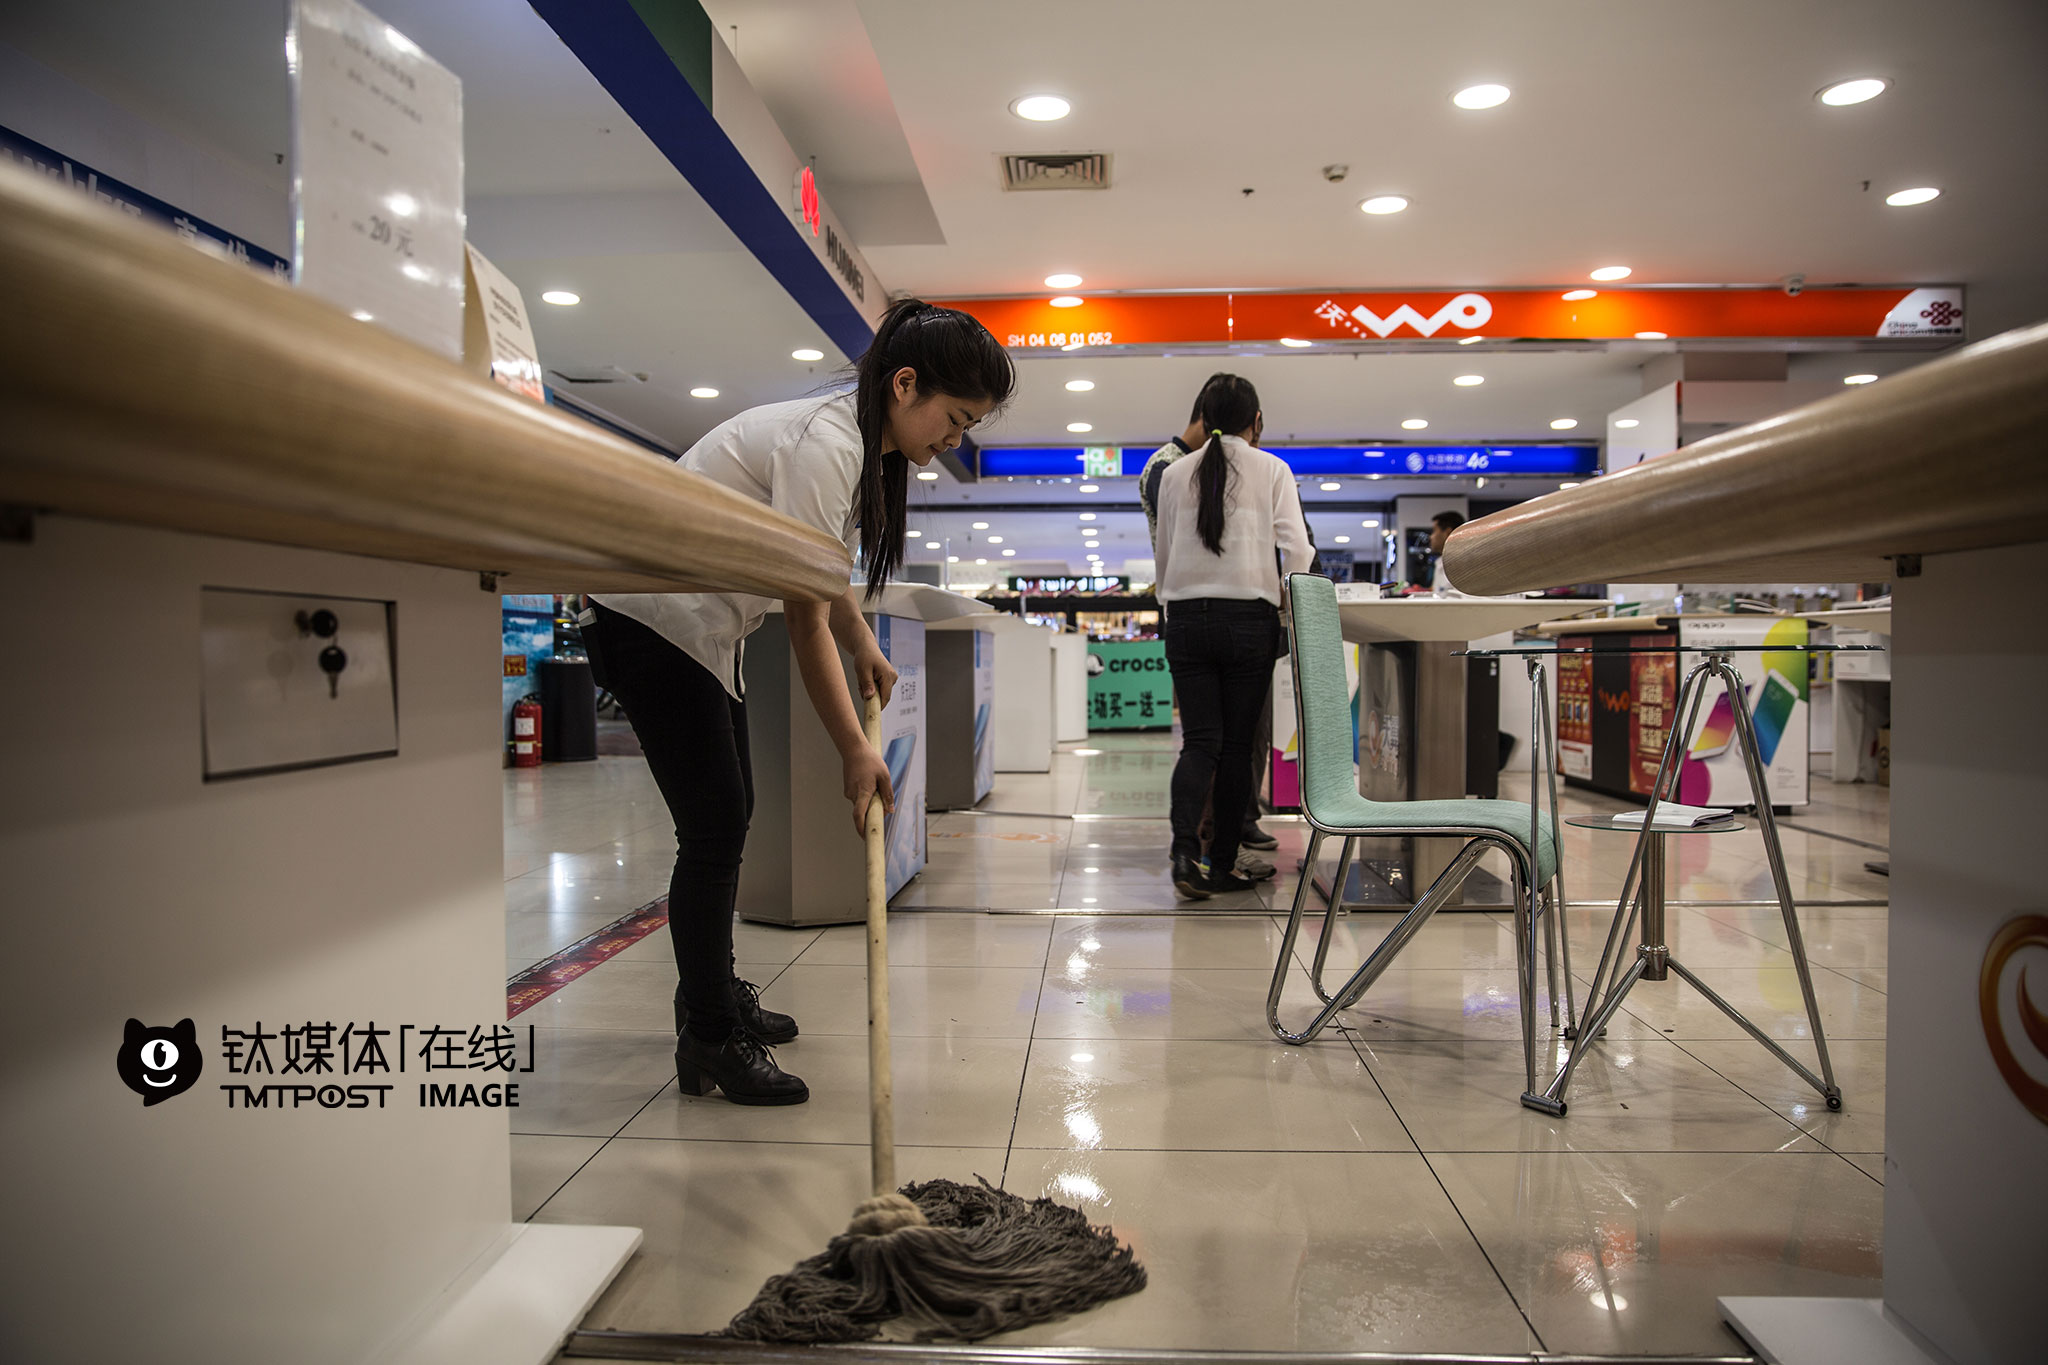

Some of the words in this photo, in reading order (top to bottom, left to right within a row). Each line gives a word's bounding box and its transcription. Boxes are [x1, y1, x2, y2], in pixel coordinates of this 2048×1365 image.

[367, 214, 392, 249] 20
[827, 225, 864, 303] HUAWEI
[1007, 333, 1026, 347] SH
[1029, 333, 1046, 347] 04
[1070, 332, 1086, 346] 01
[1088, 332, 1113, 346] 052
[1108, 657, 1166, 673] crocs
